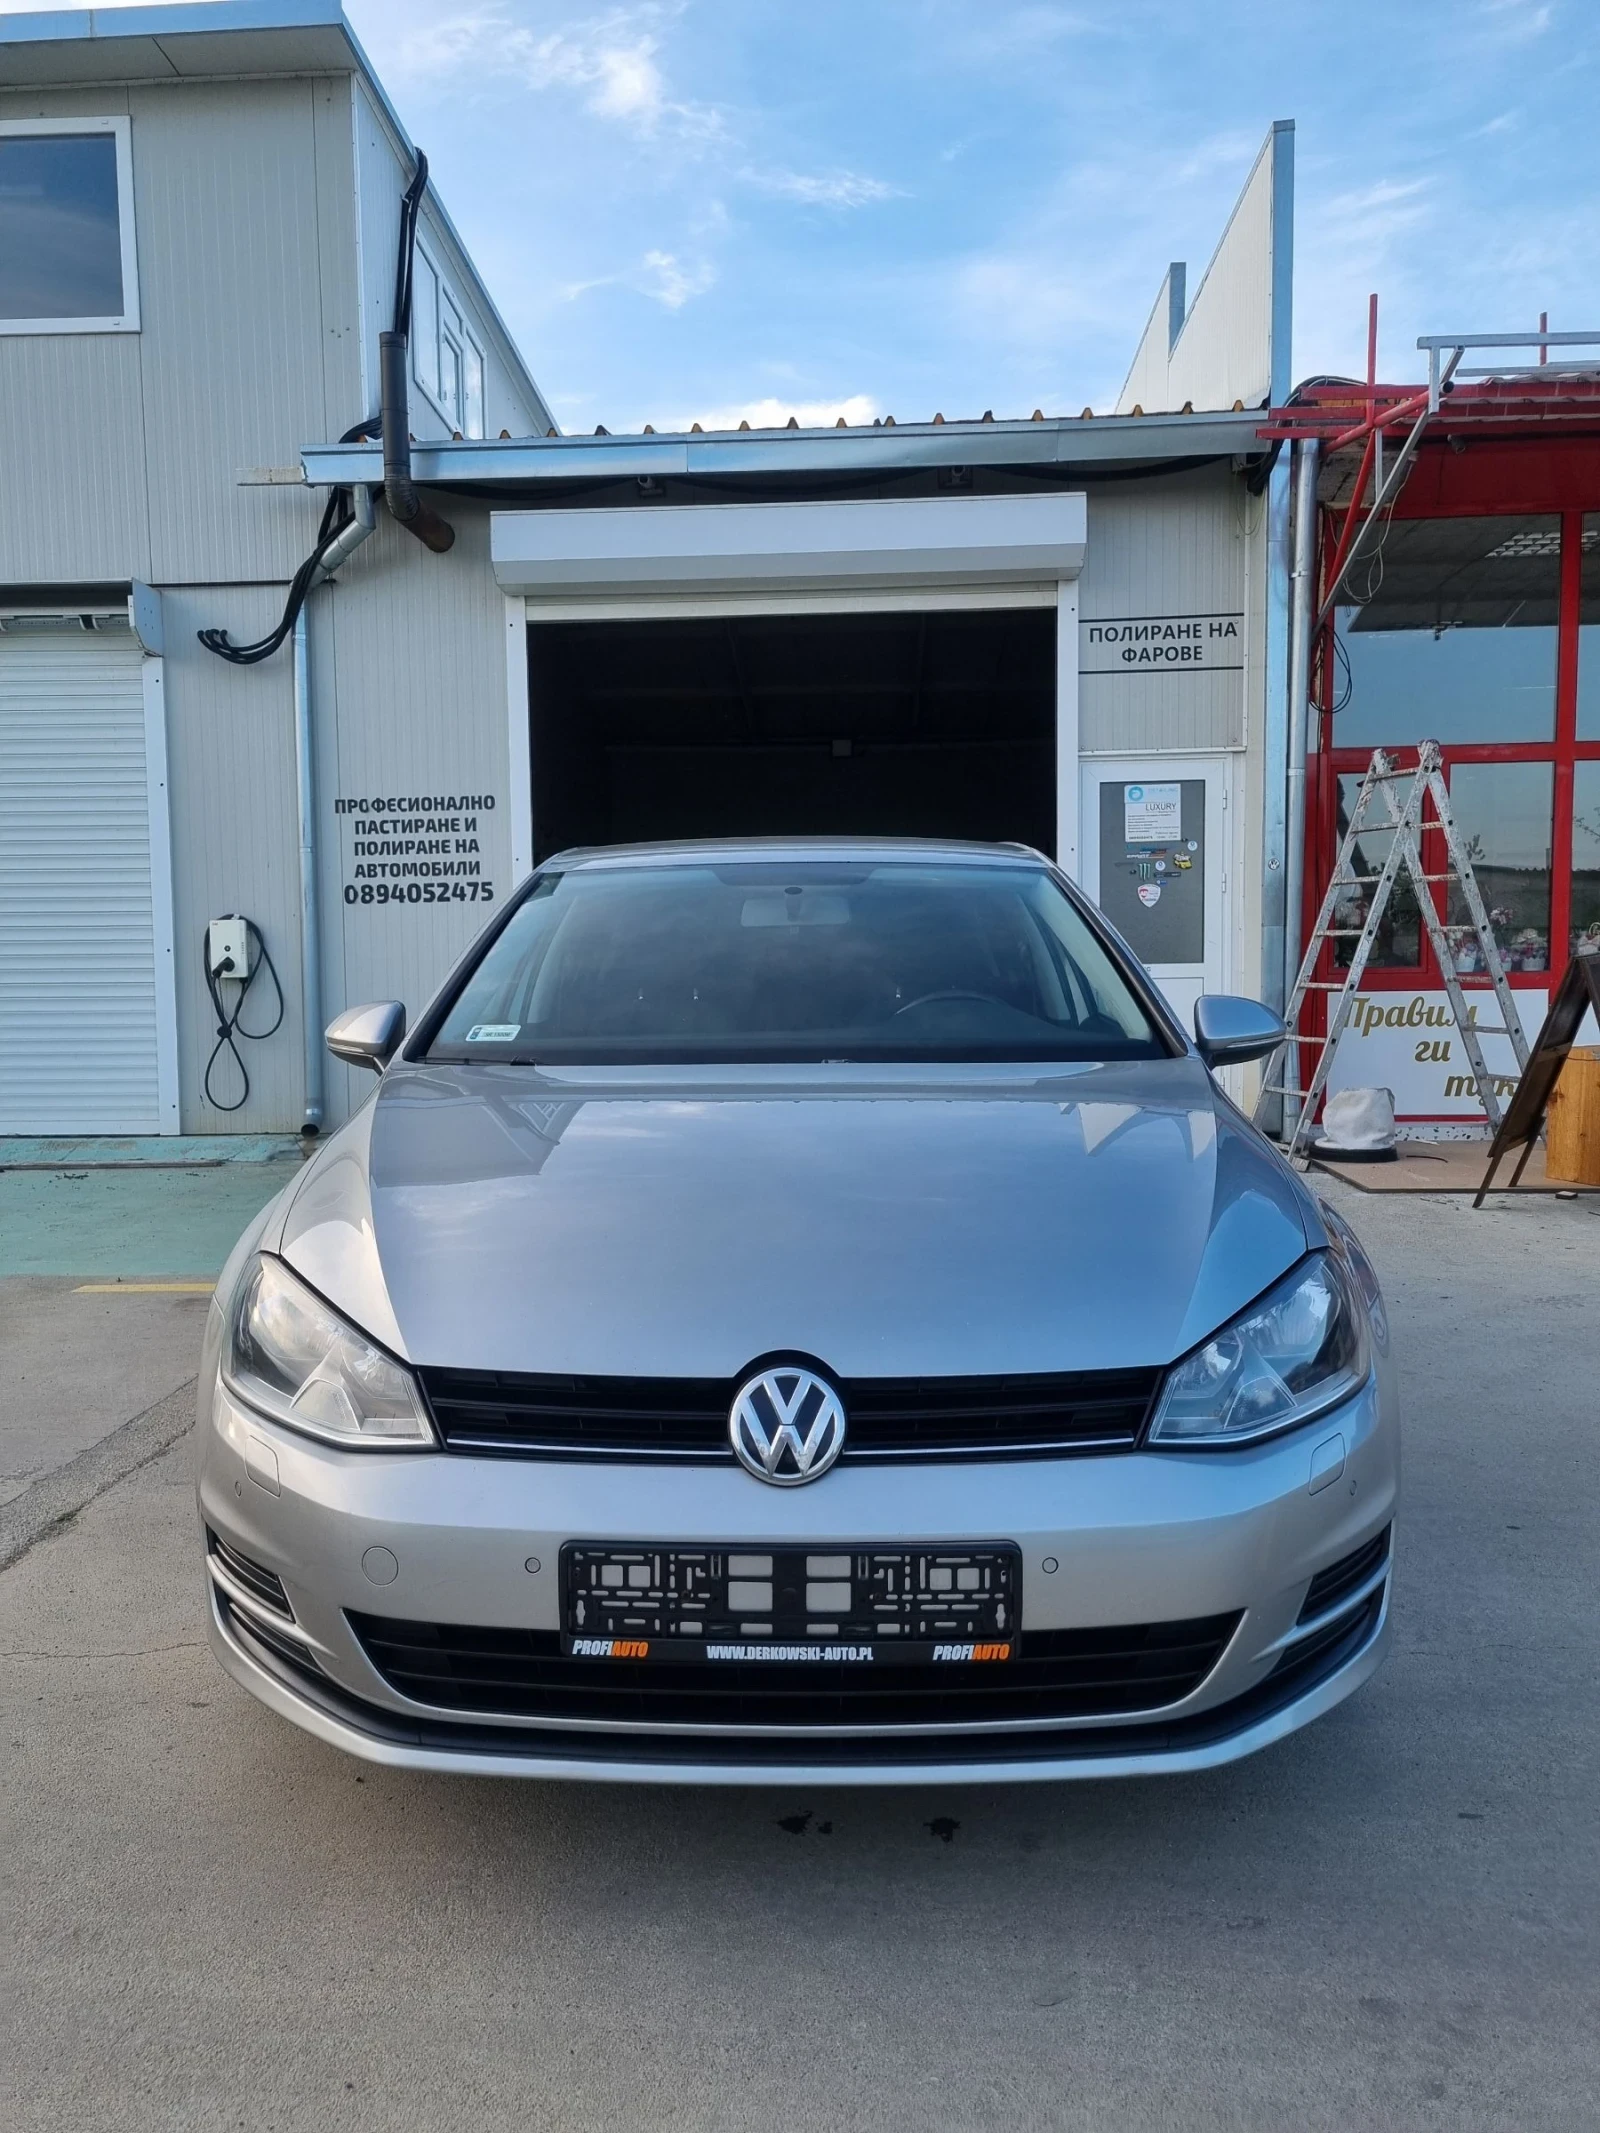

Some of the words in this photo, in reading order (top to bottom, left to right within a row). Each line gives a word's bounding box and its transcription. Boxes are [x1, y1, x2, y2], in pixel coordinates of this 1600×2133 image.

[1089, 623, 1202, 643] ПОЛИРАНЕ
[1209, 622, 1238, 638] НА
[1121, 645, 1203, 663] ФАРОВЕ
[334, 795, 496, 814] ПРОФЕСИОНАЛНО
[1145, 802, 1177, 811] LUXURY
[354, 818, 460, 835] ПАСТИРАНЕ
[464, 817, 477, 832] И
[354, 839, 451, 856] ПОЛИРАНЕ
[455, 838, 480, 853] НА
[354, 861, 481, 878] АВТОМОБИЛИ
[344, 881, 494, 904] 0894052475
[1414, 1041, 1451, 1062] ги
[572, 1639, 649, 1657] PROFIAUTO
[706, 1645, 874, 1661] WWW.DERKOWSKI-AUTO.PL
[932, 1643, 1010, 1661] PROFIAUTO
